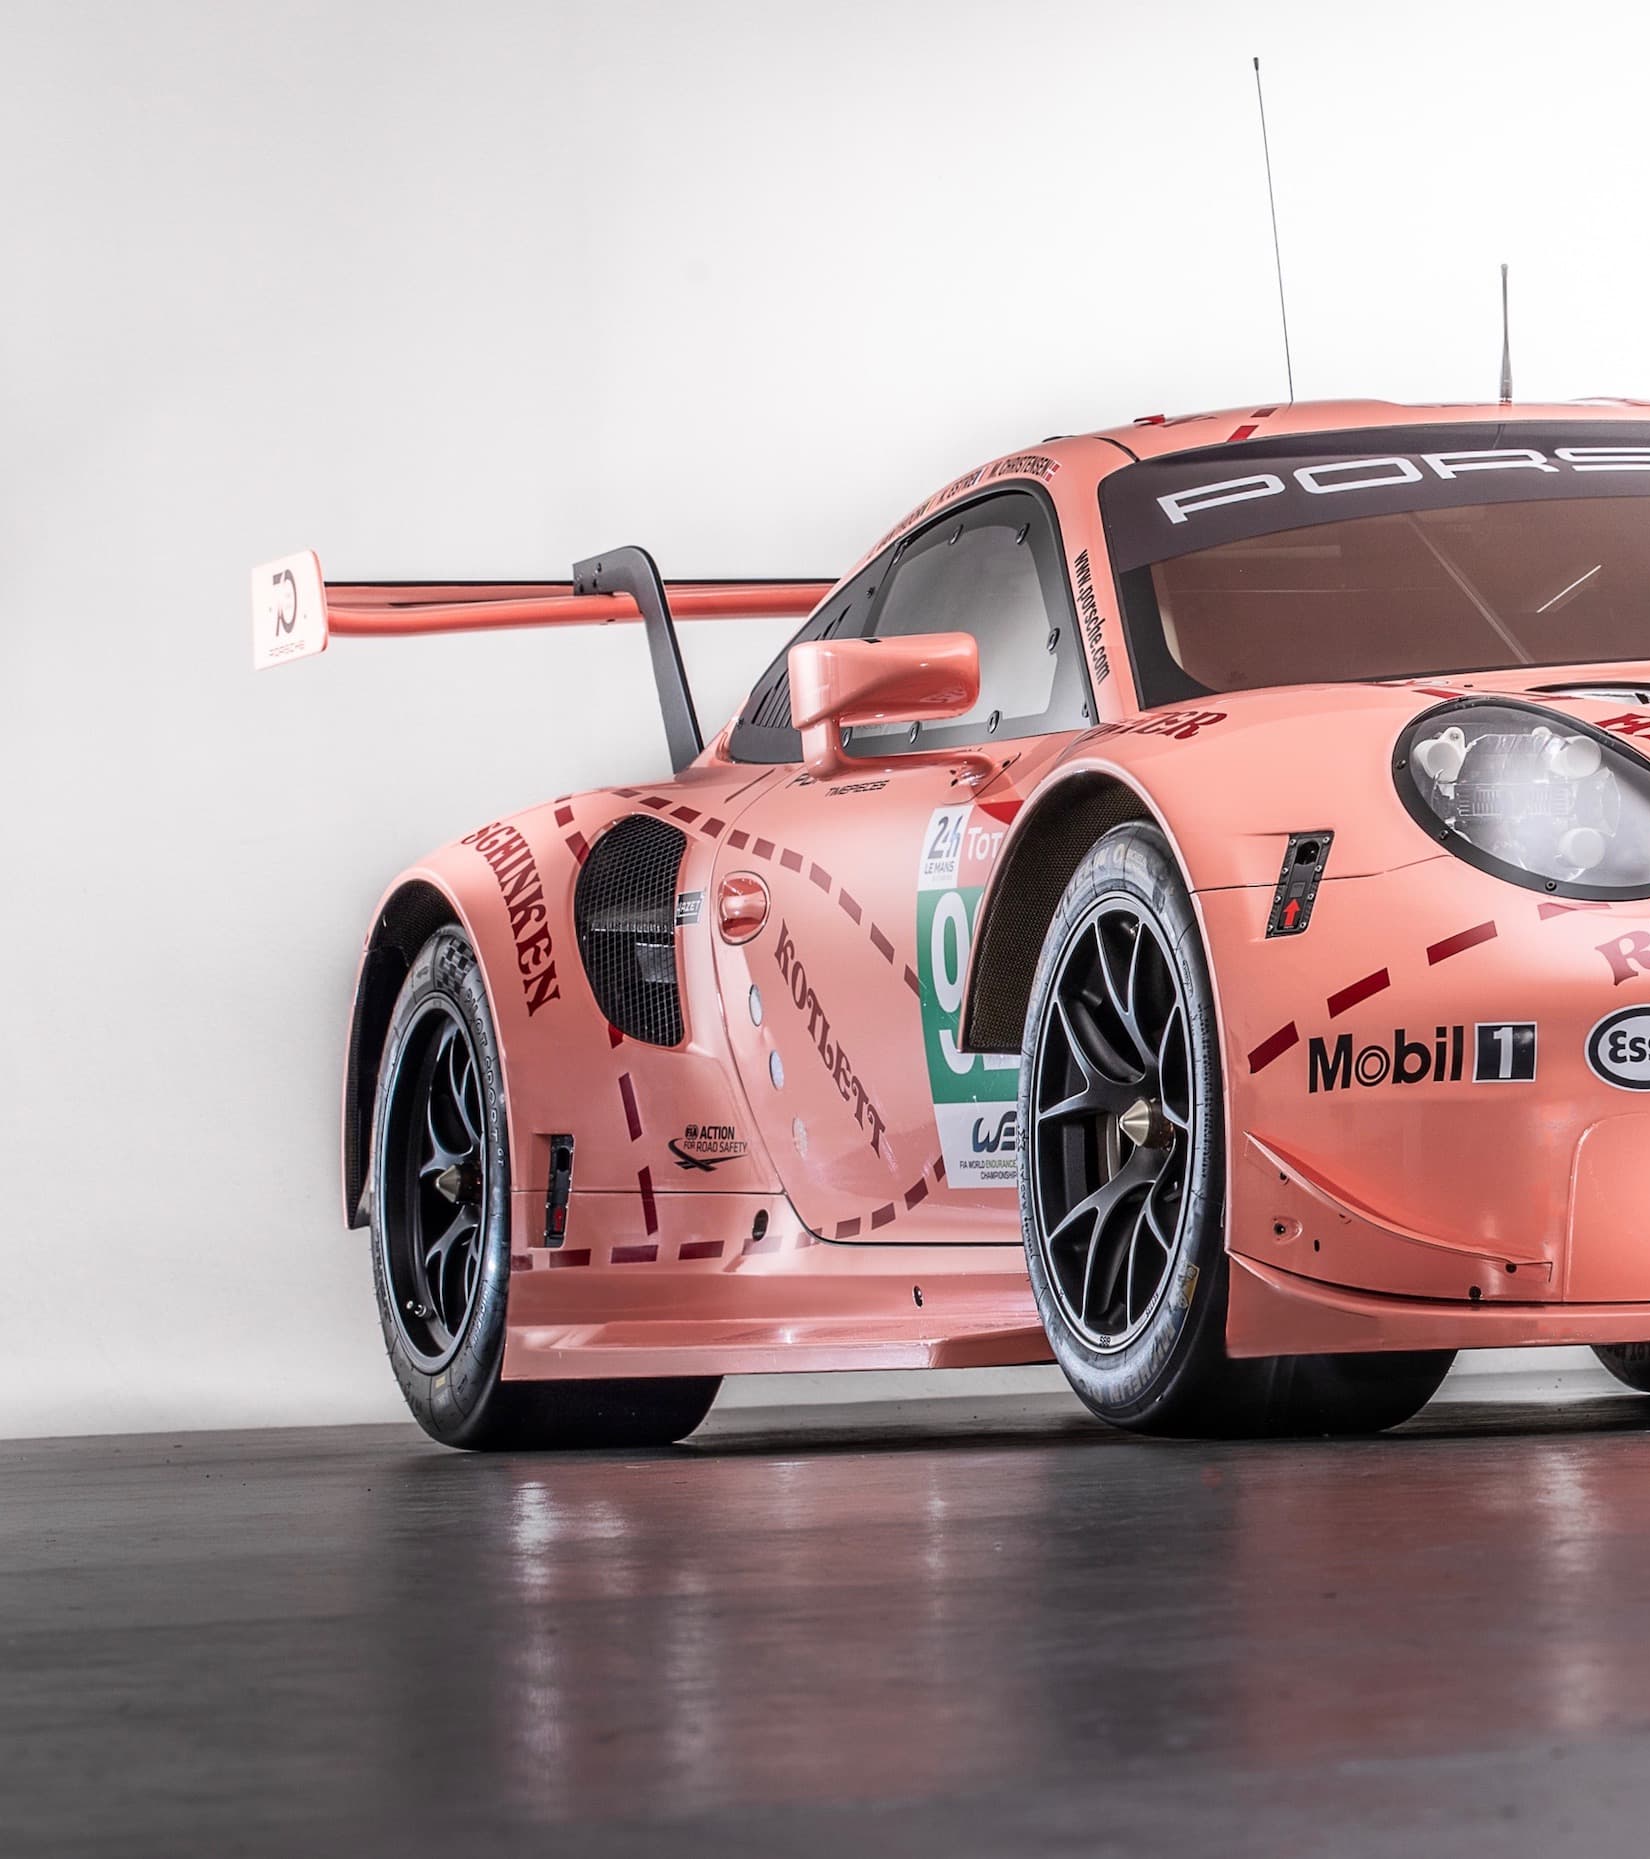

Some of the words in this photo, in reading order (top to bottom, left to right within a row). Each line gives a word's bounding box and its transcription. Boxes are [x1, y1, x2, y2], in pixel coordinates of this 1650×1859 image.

[1074, 548, 1111, 686] www.porsche.com
[967, 826, 1004, 861] TOT
[924, 862, 934, 875] LE
[934, 860, 955, 874] MANS
[461, 821, 561, 1018] SCHINKEN
[931, 891, 1021, 1075] 9
[774, 918, 887, 1159] KOTLETT
[1308, 1025, 1464, 1094] Mobil
[683, 1141, 695, 1150] FOR
[696, 1141, 718, 1153] ROAD
[719, 1141, 748, 1153] SAFETY
[699, 1125, 735, 1140] ACTION
[971, 1110, 1018, 1154] WE
[969, 1160, 985, 1169] WORLD
